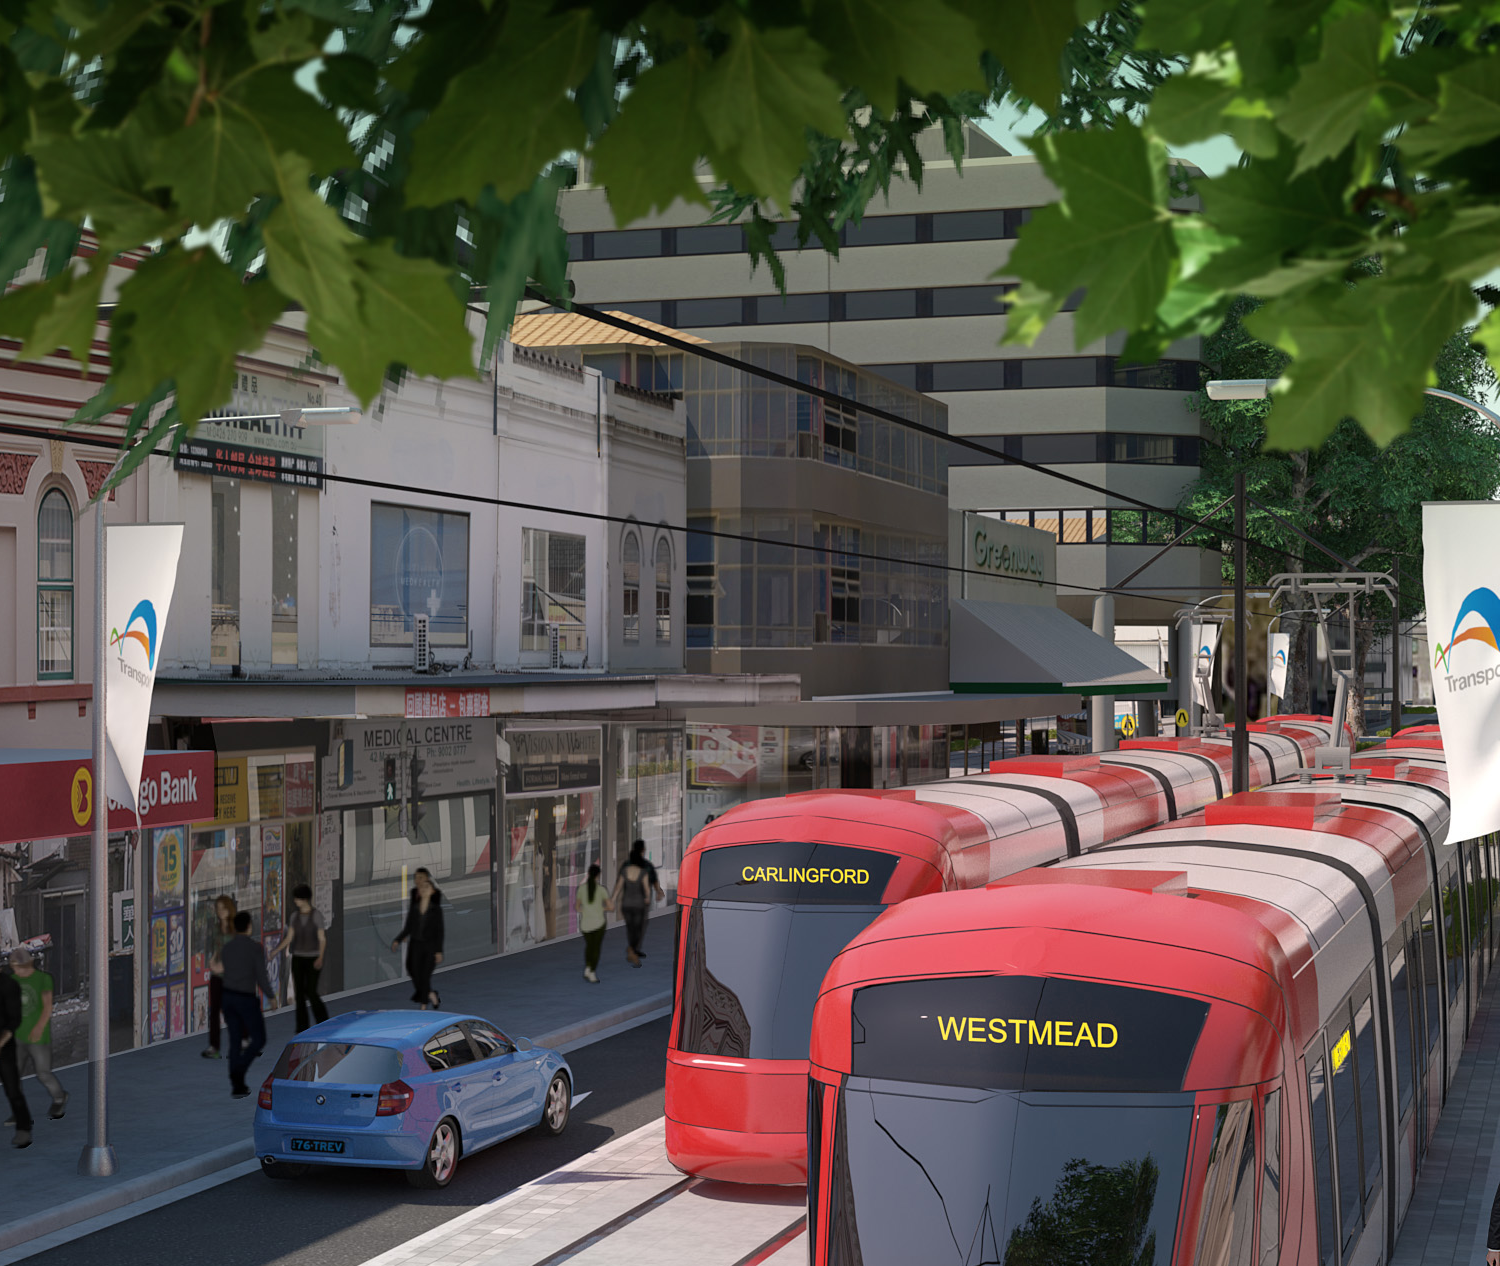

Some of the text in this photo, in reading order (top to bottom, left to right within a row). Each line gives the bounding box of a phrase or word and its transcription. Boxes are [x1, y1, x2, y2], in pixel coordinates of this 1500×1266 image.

[973, 527, 1044, 588] Greenway
[425, 724, 473, 744] CENTRE
[160, 768, 198, 806] Bank
[161, 845, 177, 872] 15
[742, 866, 870, 885] CARLINGFORD
[153, 928, 165, 948] 15
[169, 926, 184, 953] 30
[937, 1016, 1119, 1049] WESTMEAD
